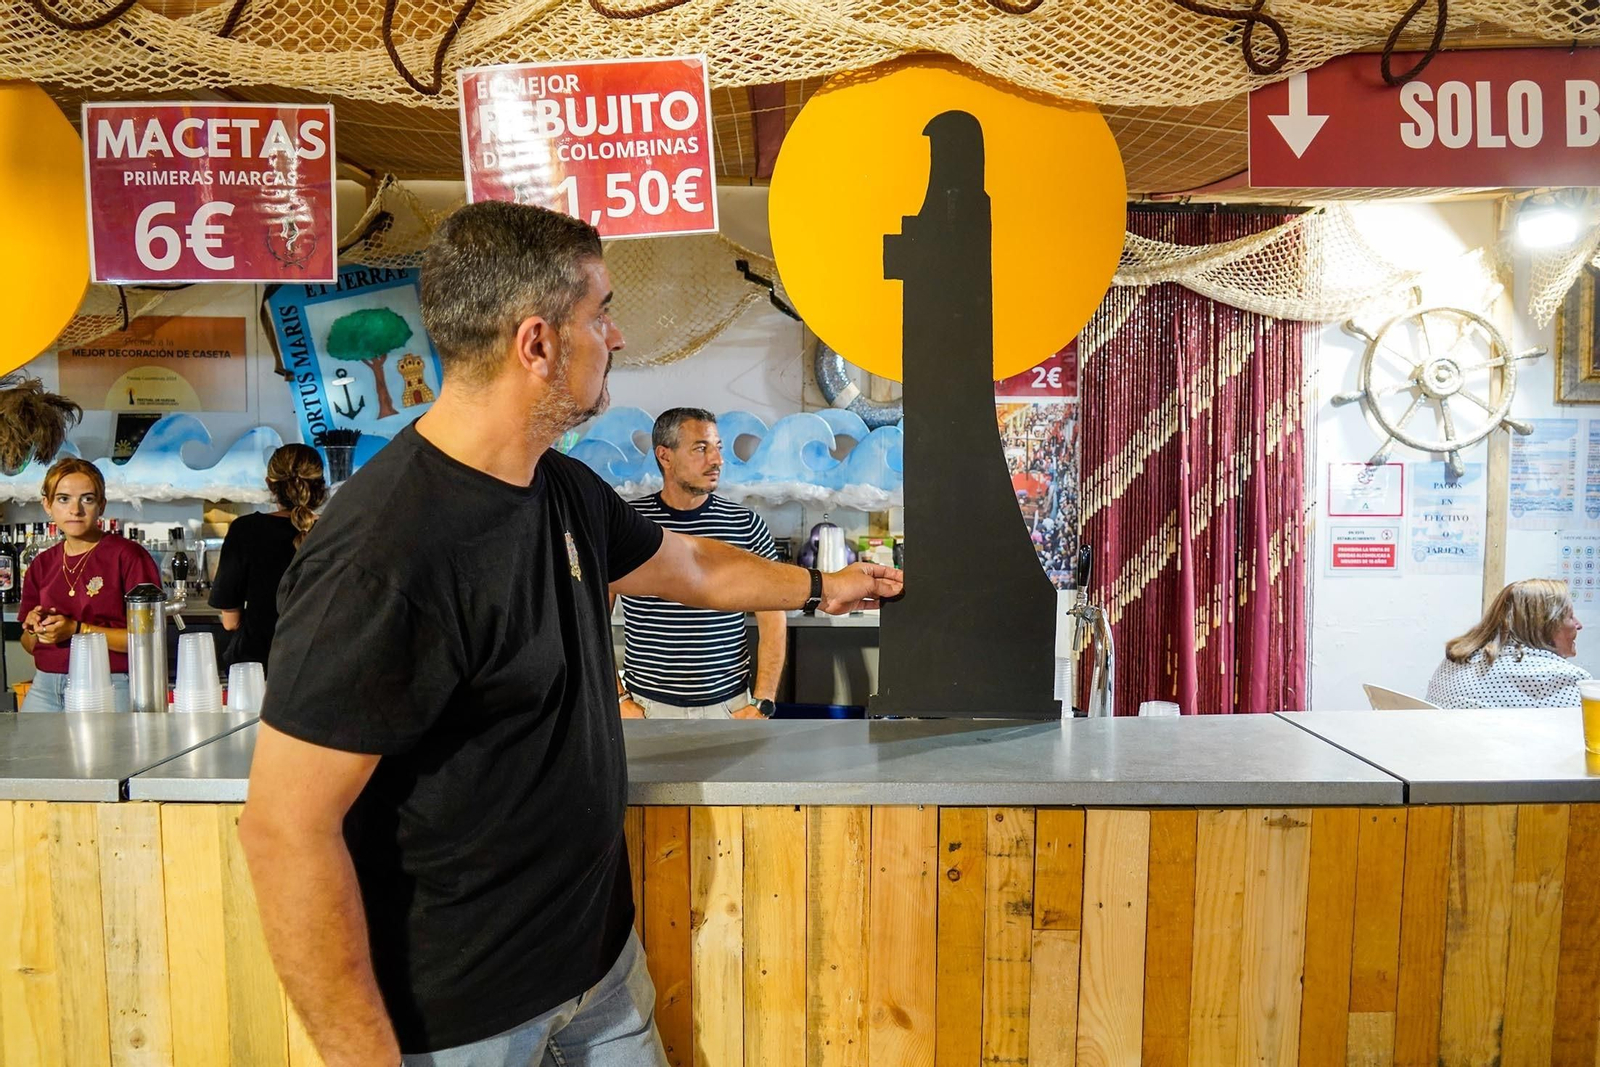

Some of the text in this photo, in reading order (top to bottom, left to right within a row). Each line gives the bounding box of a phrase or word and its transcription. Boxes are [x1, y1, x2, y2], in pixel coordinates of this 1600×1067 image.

[509, 74, 581, 98] MEJOR
[478, 90, 699, 143] REBUJITO
[1399, 79, 1543, 149] SOLO
[96, 118, 326, 160] MACETAS
[556, 136, 699, 162] COLOMBINAS
[123, 170, 297, 186] PRIMERAS MARCAS
[555, 167, 705, 226] 1,50€
[134, 201, 236, 271] 6€
[334, 266, 409, 292] TERRAE
[72, 348, 231, 359] MEJOR DECORACIÓN DE CASETA
[166, 337, 174, 346] la
[278, 304, 328, 448] PORTUS MARIS
[1031, 366, 1063, 389] 2€
[1424, 514, 1469, 522] EFECTIVO
